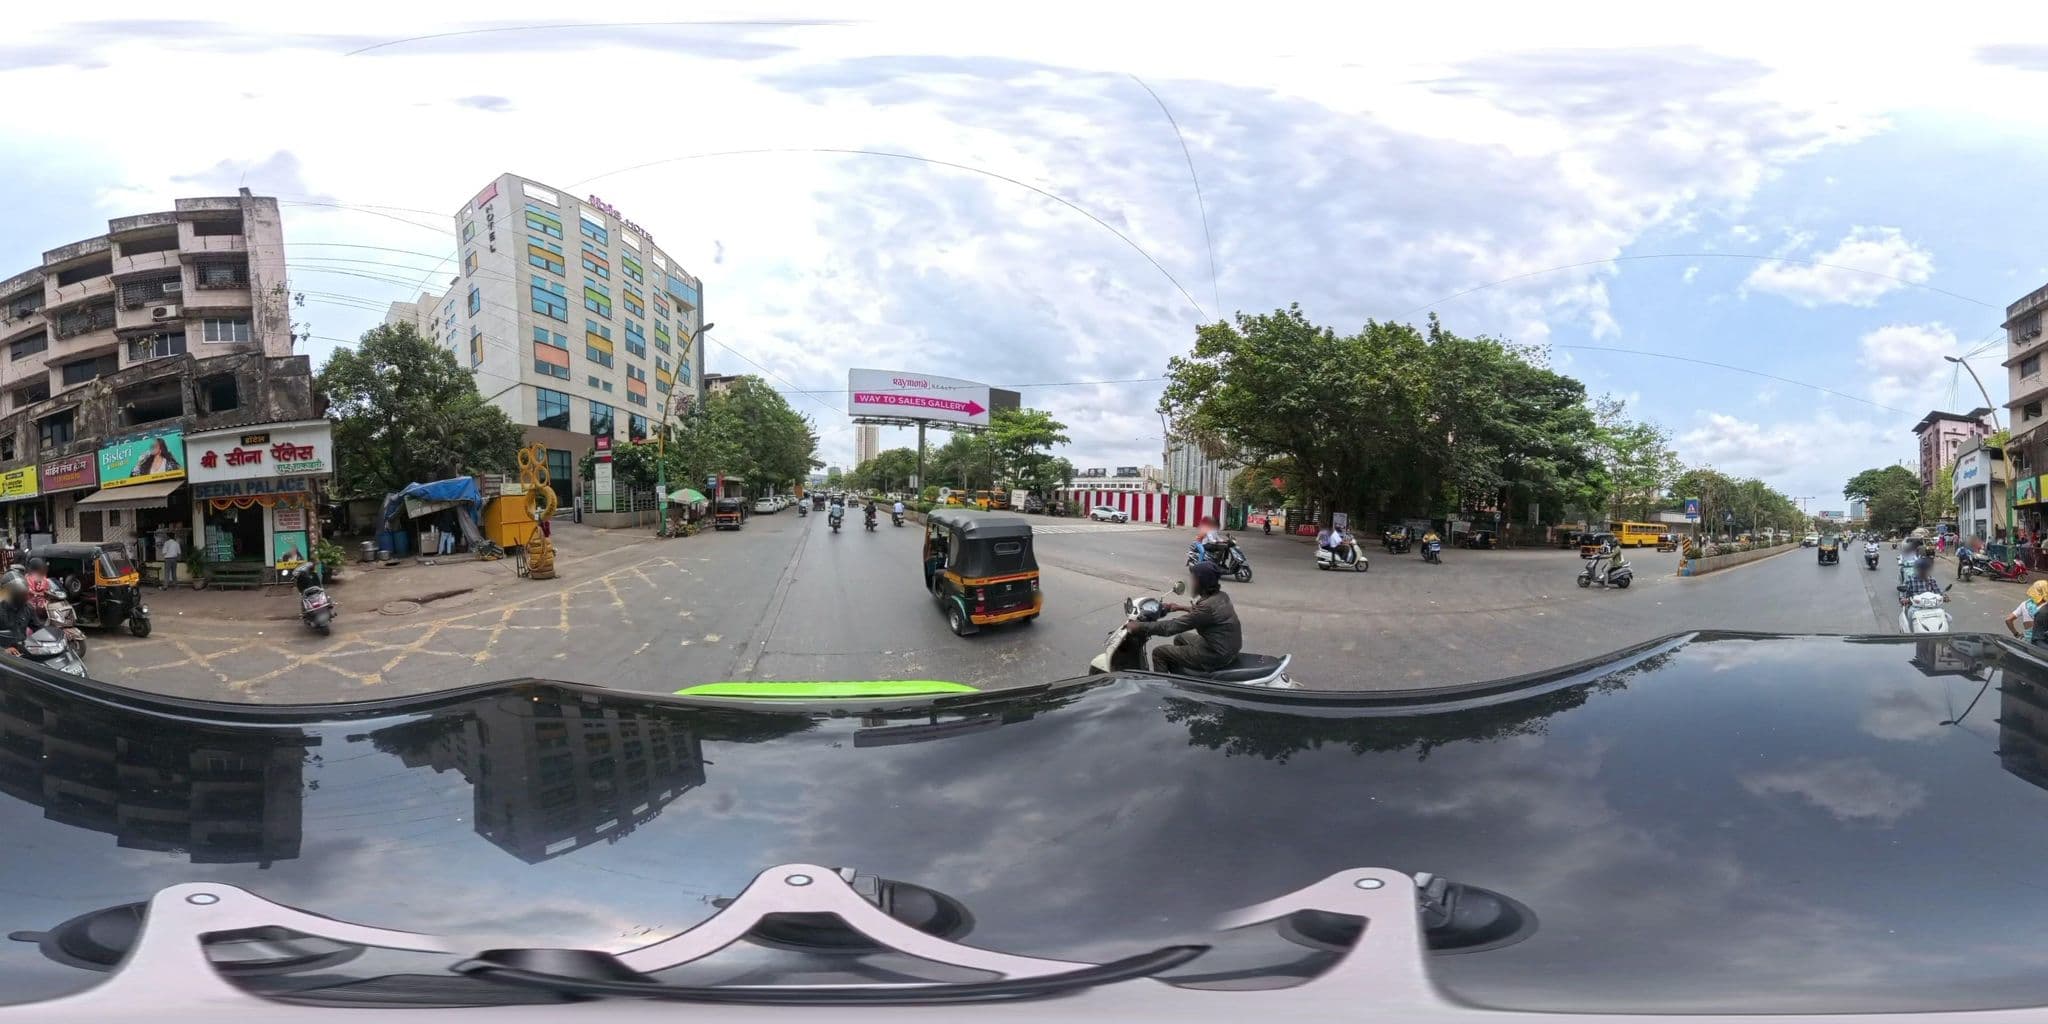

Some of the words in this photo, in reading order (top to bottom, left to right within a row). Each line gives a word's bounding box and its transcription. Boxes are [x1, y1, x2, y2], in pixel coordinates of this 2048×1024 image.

[485, 204, 496, 253] HOTEL
[625, 219, 654, 244] HOTEL
[859, 395, 881, 403] WAY
[883, 395, 896, 404] TO
[898, 397, 926, 406] SALES
[928, 399, 966, 411] GALLERY
[102, 446, 133, 465] Bisleri
[201, 450, 218, 468] श्री
[224, 447, 263, 466] सीना
[270, 443, 314, 461] पॅलेस
[246, 478, 306, 494] PALACE
